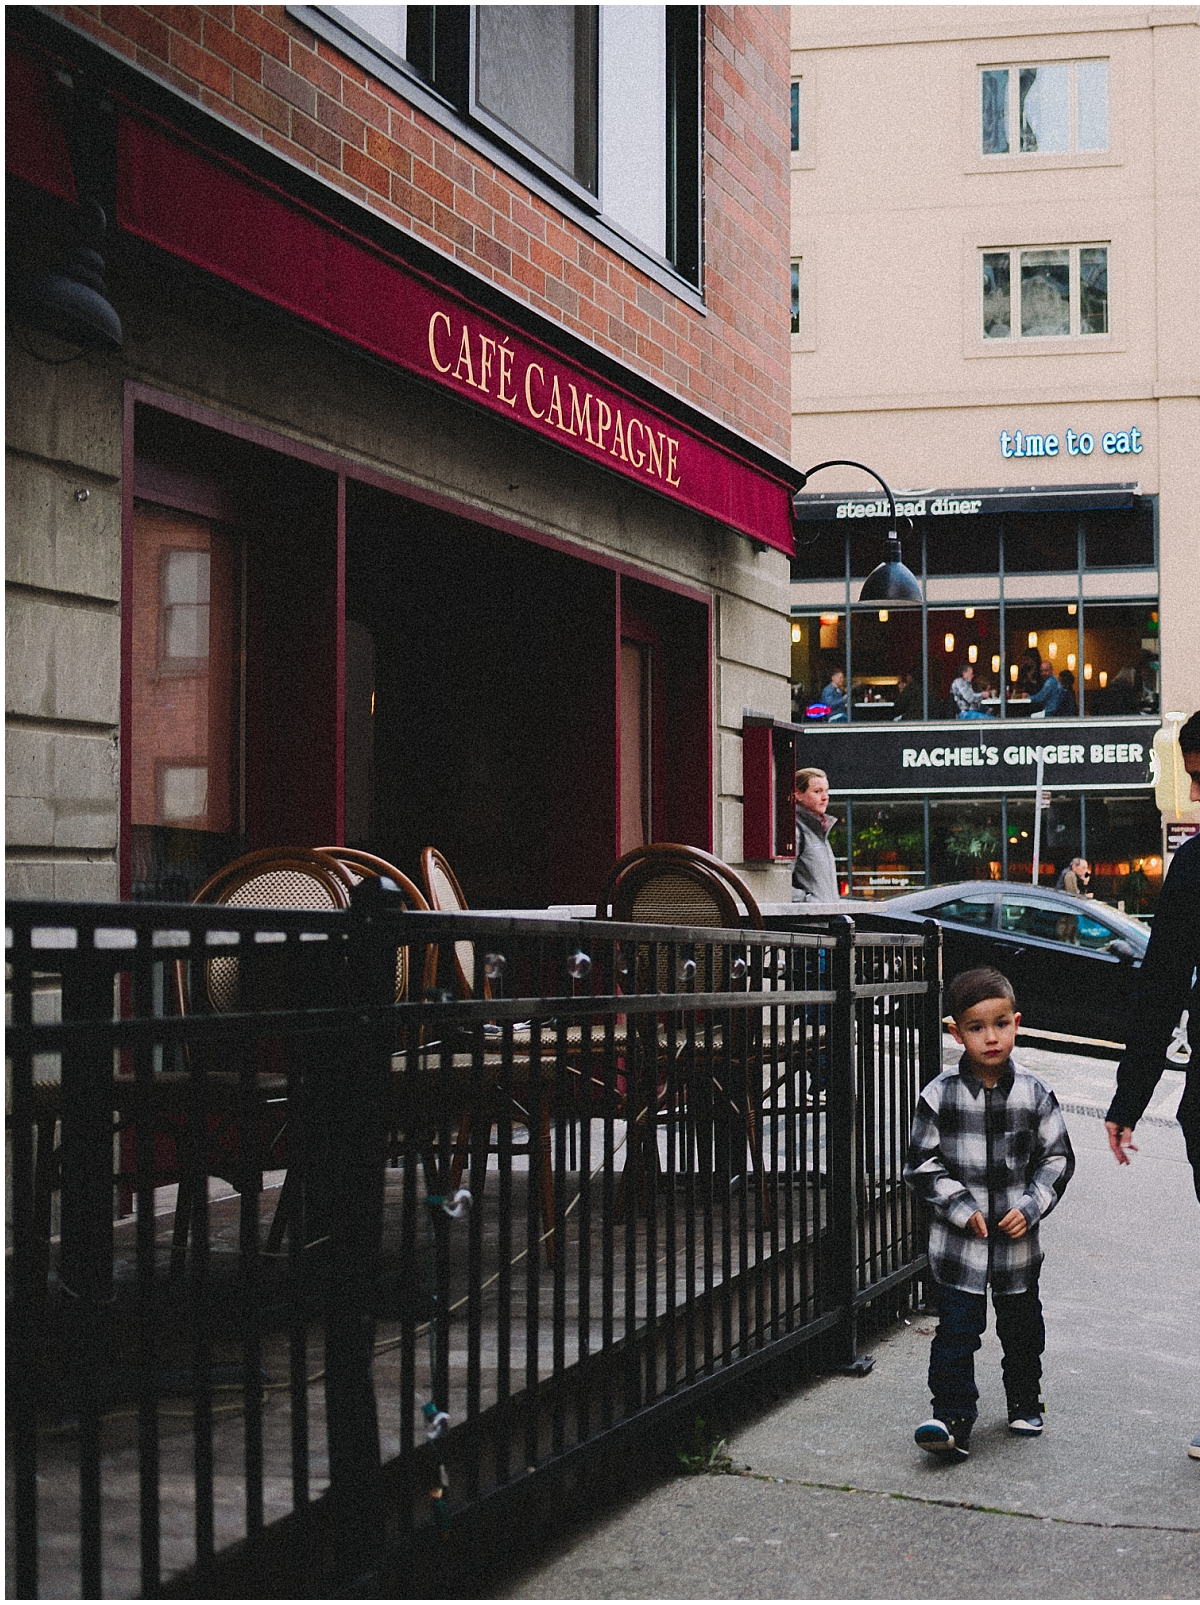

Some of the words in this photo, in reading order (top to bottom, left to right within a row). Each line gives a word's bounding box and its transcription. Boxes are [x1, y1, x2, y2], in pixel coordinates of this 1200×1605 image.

[428, 311, 517, 408] CAFÉ
[524, 362, 681, 488] CAMPAGNE
[1000, 429, 1059, 458] time
[1066, 428, 1095, 456] to
[1102, 426, 1143, 455] eat
[930, 498, 982, 515] diner
[902, 745, 999, 767] RACHEL'S
[1090, 744, 1143, 763] BEER
